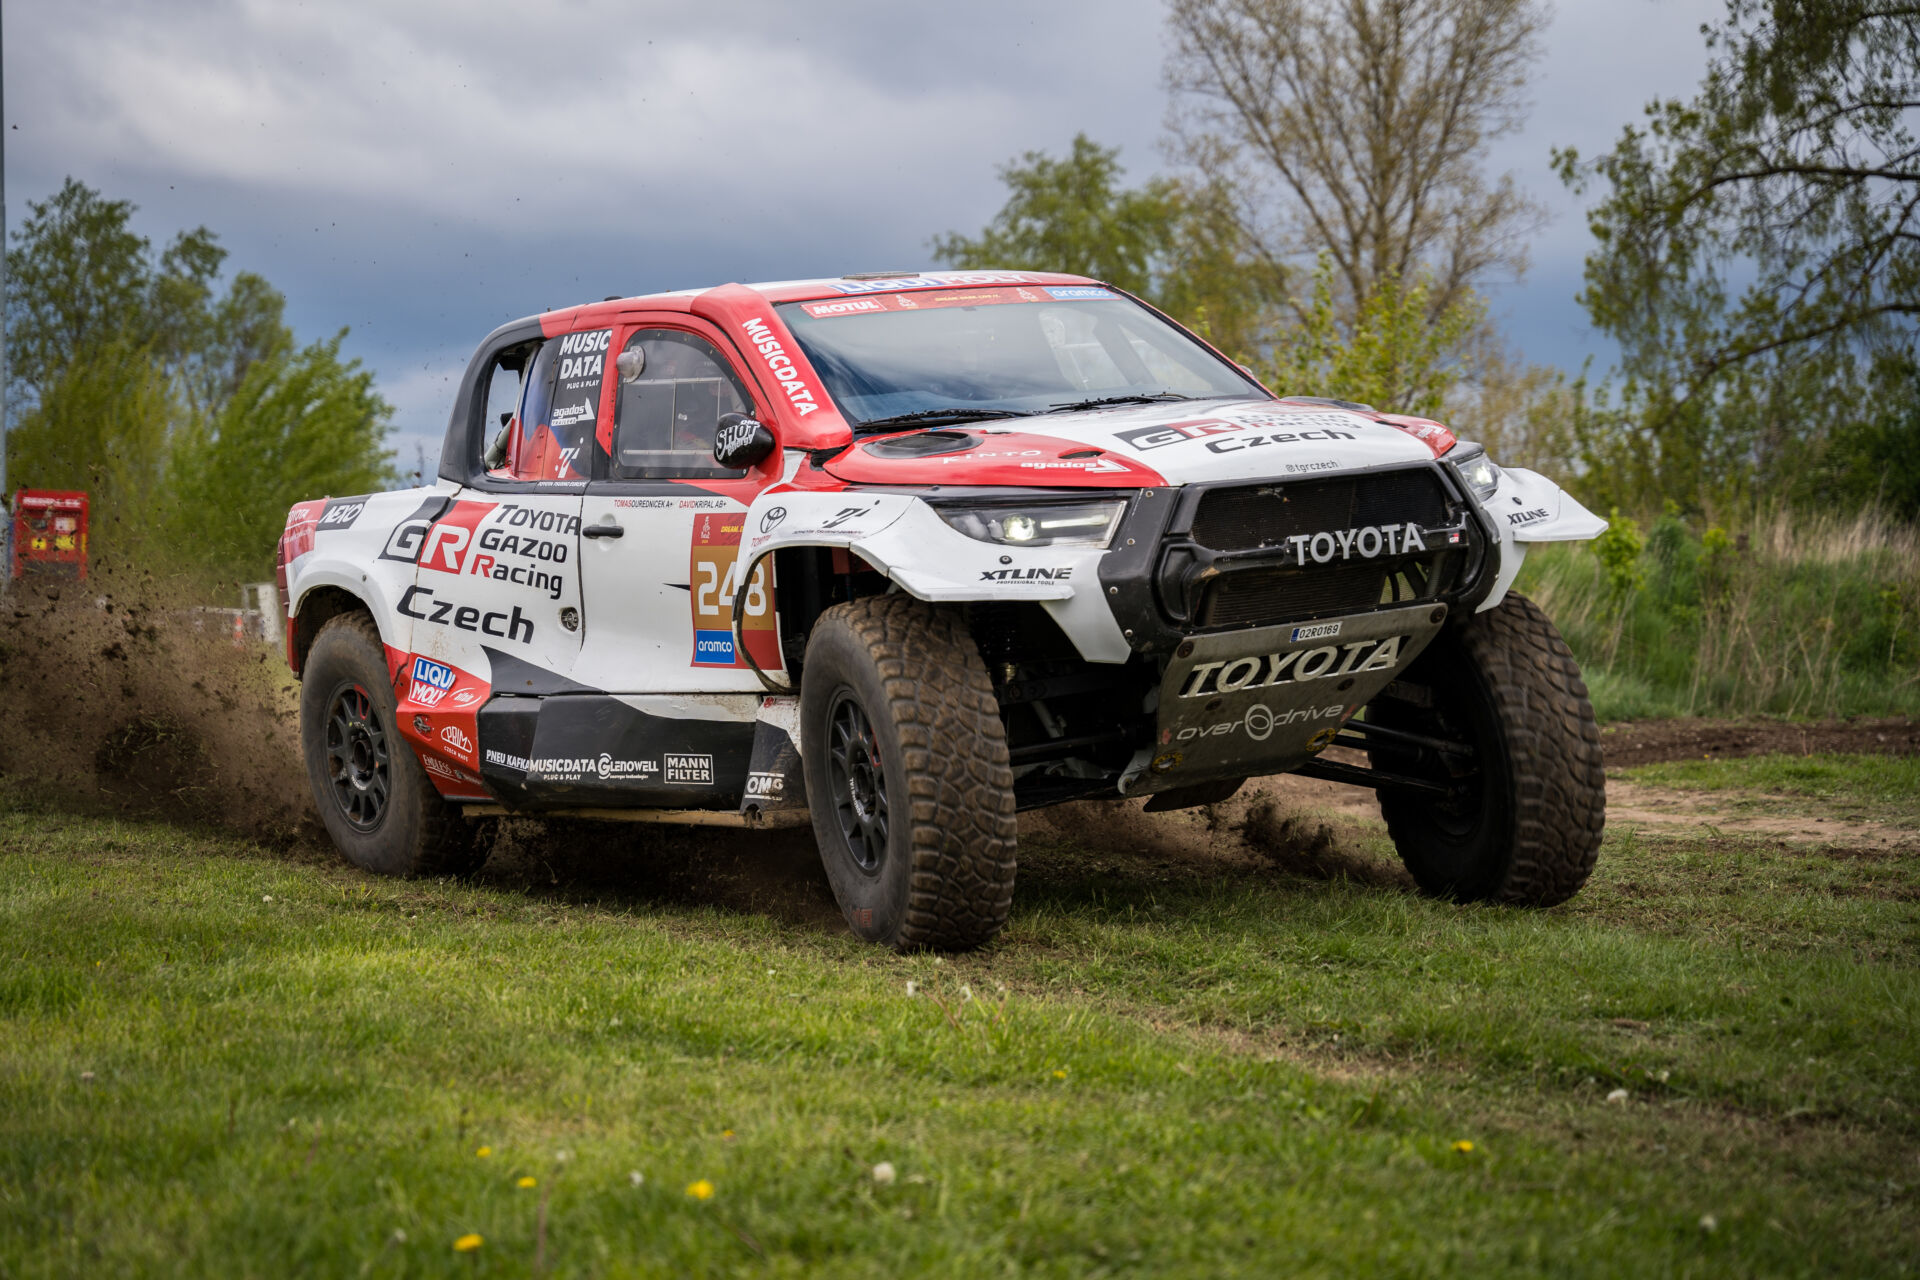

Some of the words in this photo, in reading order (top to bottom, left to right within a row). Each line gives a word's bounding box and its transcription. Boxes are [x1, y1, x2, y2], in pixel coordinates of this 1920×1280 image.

[836, 278, 940, 292] LIQUI
[1052, 289, 1110, 297] aramco
[812, 301, 880, 315] MOTUL
[559, 330, 612, 356] MUSIC
[559, 355, 602, 380] DATA
[742, 317, 819, 416] MUSICDATA
[586, 380, 600, 388] PLAY
[553, 404, 585, 419] agados
[716, 425, 757, 460] SHOT
[1131, 421, 1241, 451] GR
[1205, 429, 1356, 454] Czech
[943, 450, 1041, 464] KINTO
[1020, 461, 1097, 470] agados
[1286, 460, 1338, 472] @tgrczech
[715, 500, 727, 508] AB+
[495, 504, 582, 537] TOYOTA
[1506, 508, 1550, 525] XTLINE
[385, 519, 471, 571] GR
[478, 528, 569, 563] GAZOO
[1289, 522, 1426, 565] TOYOTA
[470, 553, 563, 600] Racing
[979, 567, 1073, 581] XTLINE
[396, 584, 536, 644] Czech
[1299, 624, 1339, 639] 02R0169
[698, 641, 733, 653] aramco
[416, 661, 456, 691] LIQUI
[1186, 636, 1402, 698] TOYOTA
[411, 682, 447, 705] MOLY
[446, 726, 469, 750] PRIM
[486, 749, 506, 764] PNEU
[506, 755, 530, 771] KAFKA
[529, 758, 596, 773] MUSICDATA
[667, 757, 710, 769] MANN
[667, 769, 711, 781] FILTER
